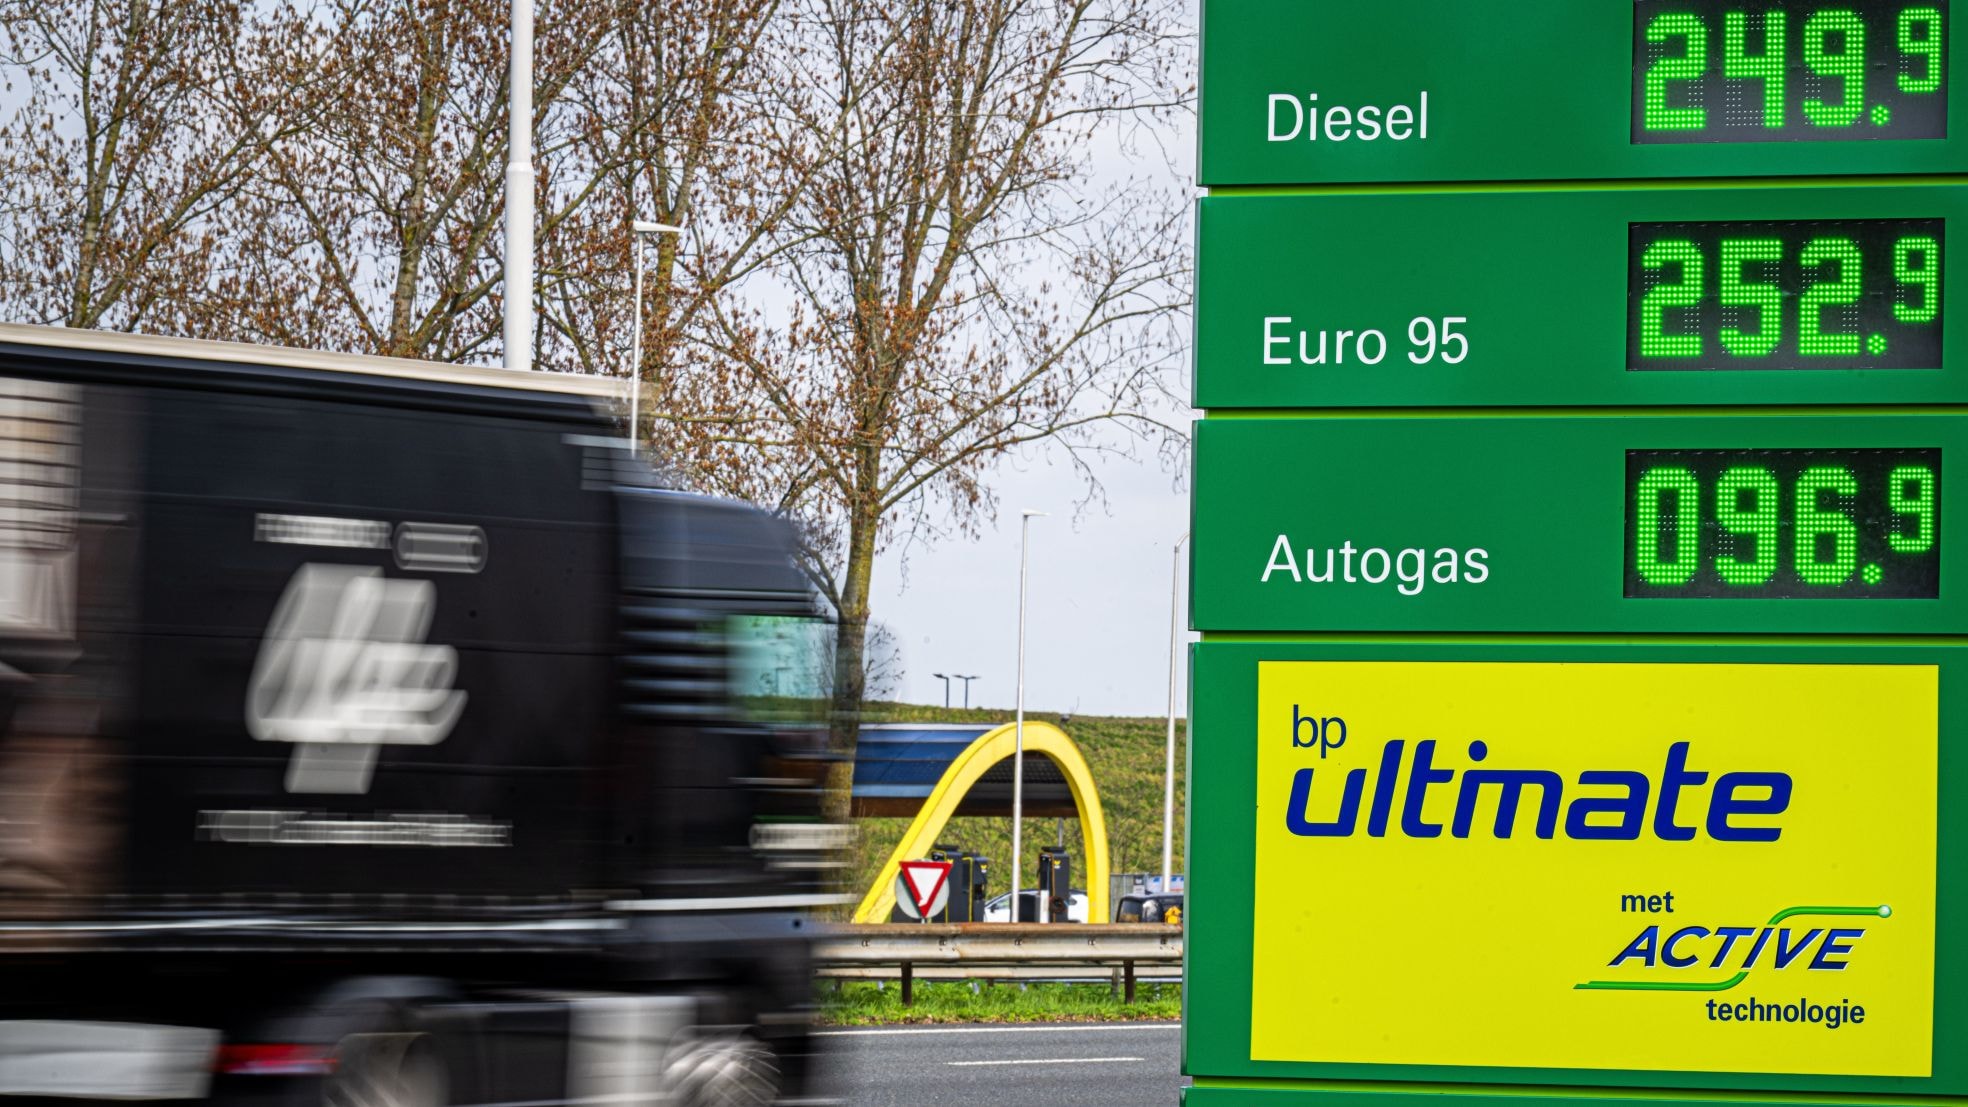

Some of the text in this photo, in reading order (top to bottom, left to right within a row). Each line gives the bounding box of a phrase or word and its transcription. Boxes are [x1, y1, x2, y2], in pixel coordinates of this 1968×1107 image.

[1644, 7, 1942, 131] 249.9
[1266, 91, 1429, 142] Diesel
[1640, 237, 1938, 357] 252.9
[1262, 315, 1470, 366] Euro 95
[1636, 466, 1934, 586] 096.9
[1260, 534, 1490, 596] Autogas
[1291, 704, 1348, 759] bp
[1285, 739, 1793, 842] ultimate
[1620, 890, 1675, 914] met
[1607, 924, 1867, 972] ACTIVE
[1705, 996, 1866, 1030] technologie
